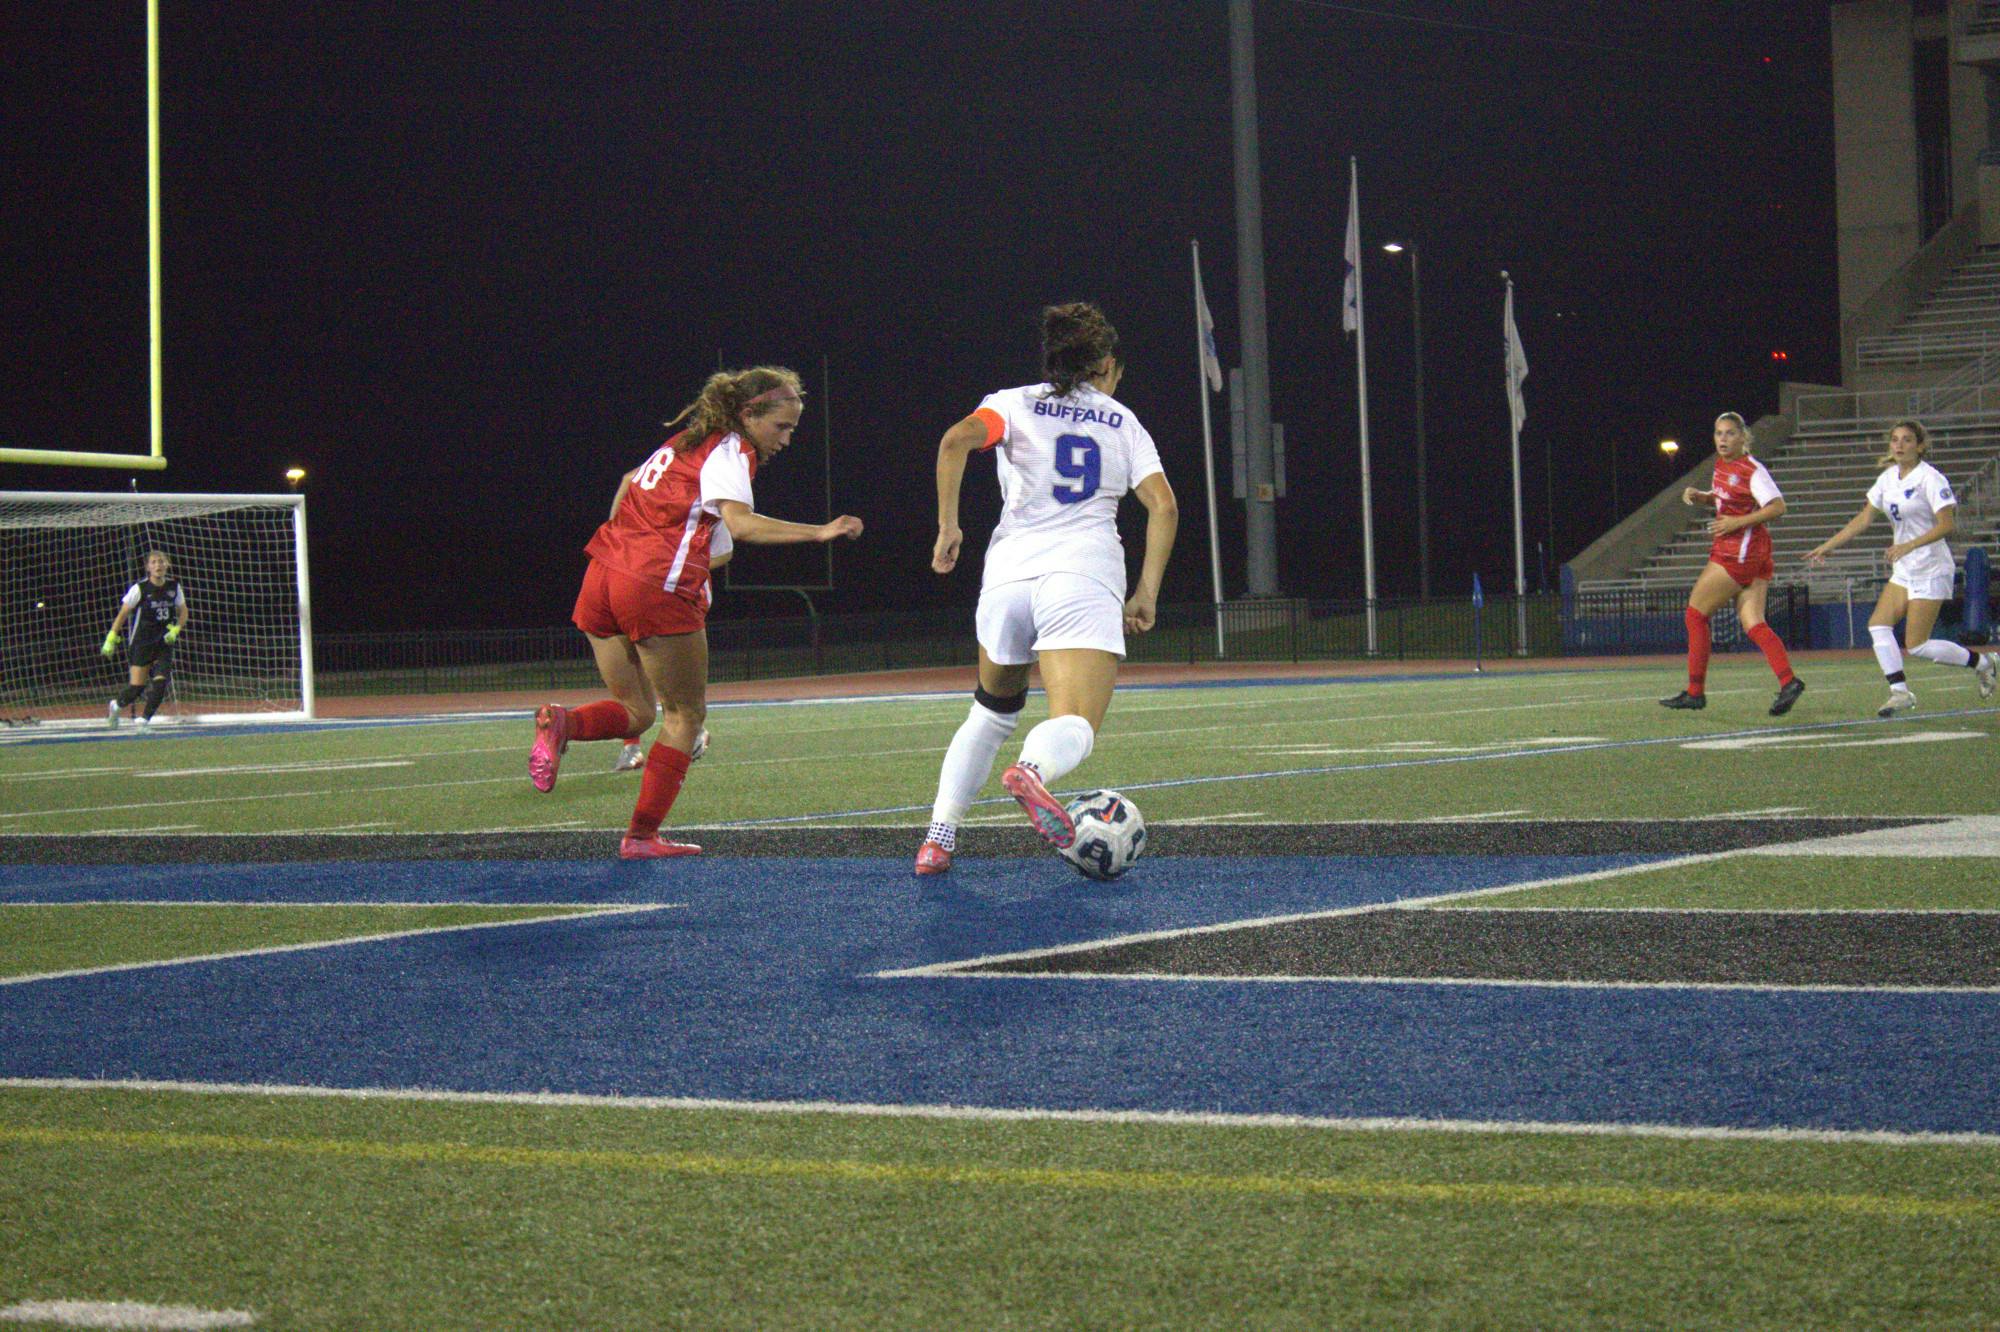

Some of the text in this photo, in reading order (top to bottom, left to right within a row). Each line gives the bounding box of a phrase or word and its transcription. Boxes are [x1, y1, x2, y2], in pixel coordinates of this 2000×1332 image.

[1033, 400, 1123, 429] BUFFALO
[1053, 433, 1101, 505] 9
[1890, 504, 1902, 521] 2
[156, 607, 170, 621] 33
